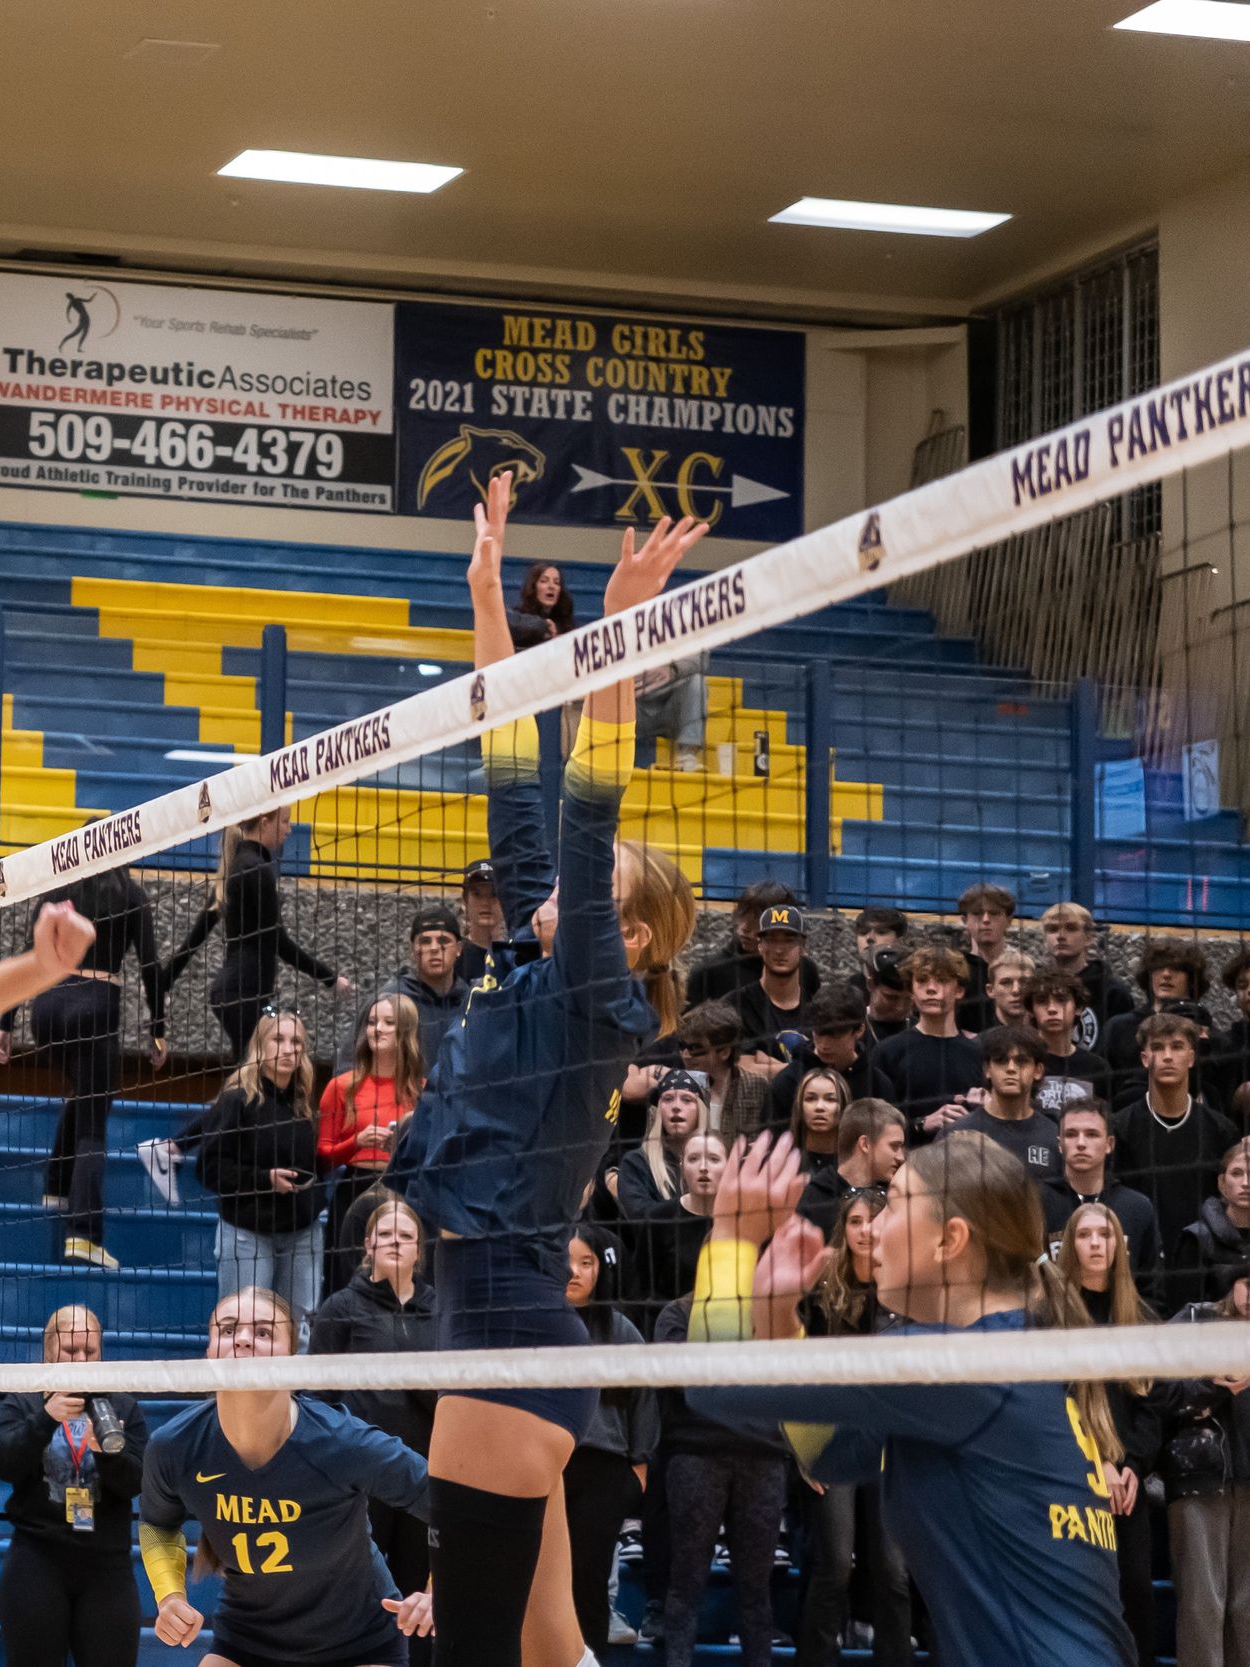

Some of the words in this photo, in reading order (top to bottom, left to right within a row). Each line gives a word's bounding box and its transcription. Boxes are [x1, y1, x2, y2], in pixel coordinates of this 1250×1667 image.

[502, 315, 597, 353] MEAD
[611, 325, 705, 361] GIRLS
[474, 348, 571, 385] CROSS
[586, 358, 733, 399] COUNTRY
[160, 394, 269, 418] PHYSICAL
[280, 403, 382, 427] THERAPY
[409, 379, 475, 415] 2021
[491, 385, 593, 422] STATE
[607, 394, 796, 439] CHAMPIONS
[28, 411, 345, 479] 509-466-4379
[1011, 428, 1091, 507] MEAD
[36, 465, 100, 485] Athletic
[105, 470, 172, 494] Training
[178, 476, 247, 495] Provider
[253, 482, 276, 497] for
[281, 484, 310, 500] The
[315, 486, 387, 505] Panthers
[573, 619, 627, 678] MEAD
[636, 568, 746, 653] PANTHERS
[270, 749, 310, 794] MEAD
[315, 711, 392, 778] PANTHERS
[50, 841, 80, 876] MEAD
[84, 809, 142, 861] PANTHERS
[771, 909, 789, 924] M
[216, 1493, 302, 1523] MEAD
[232, 1531, 293, 1575] 12
